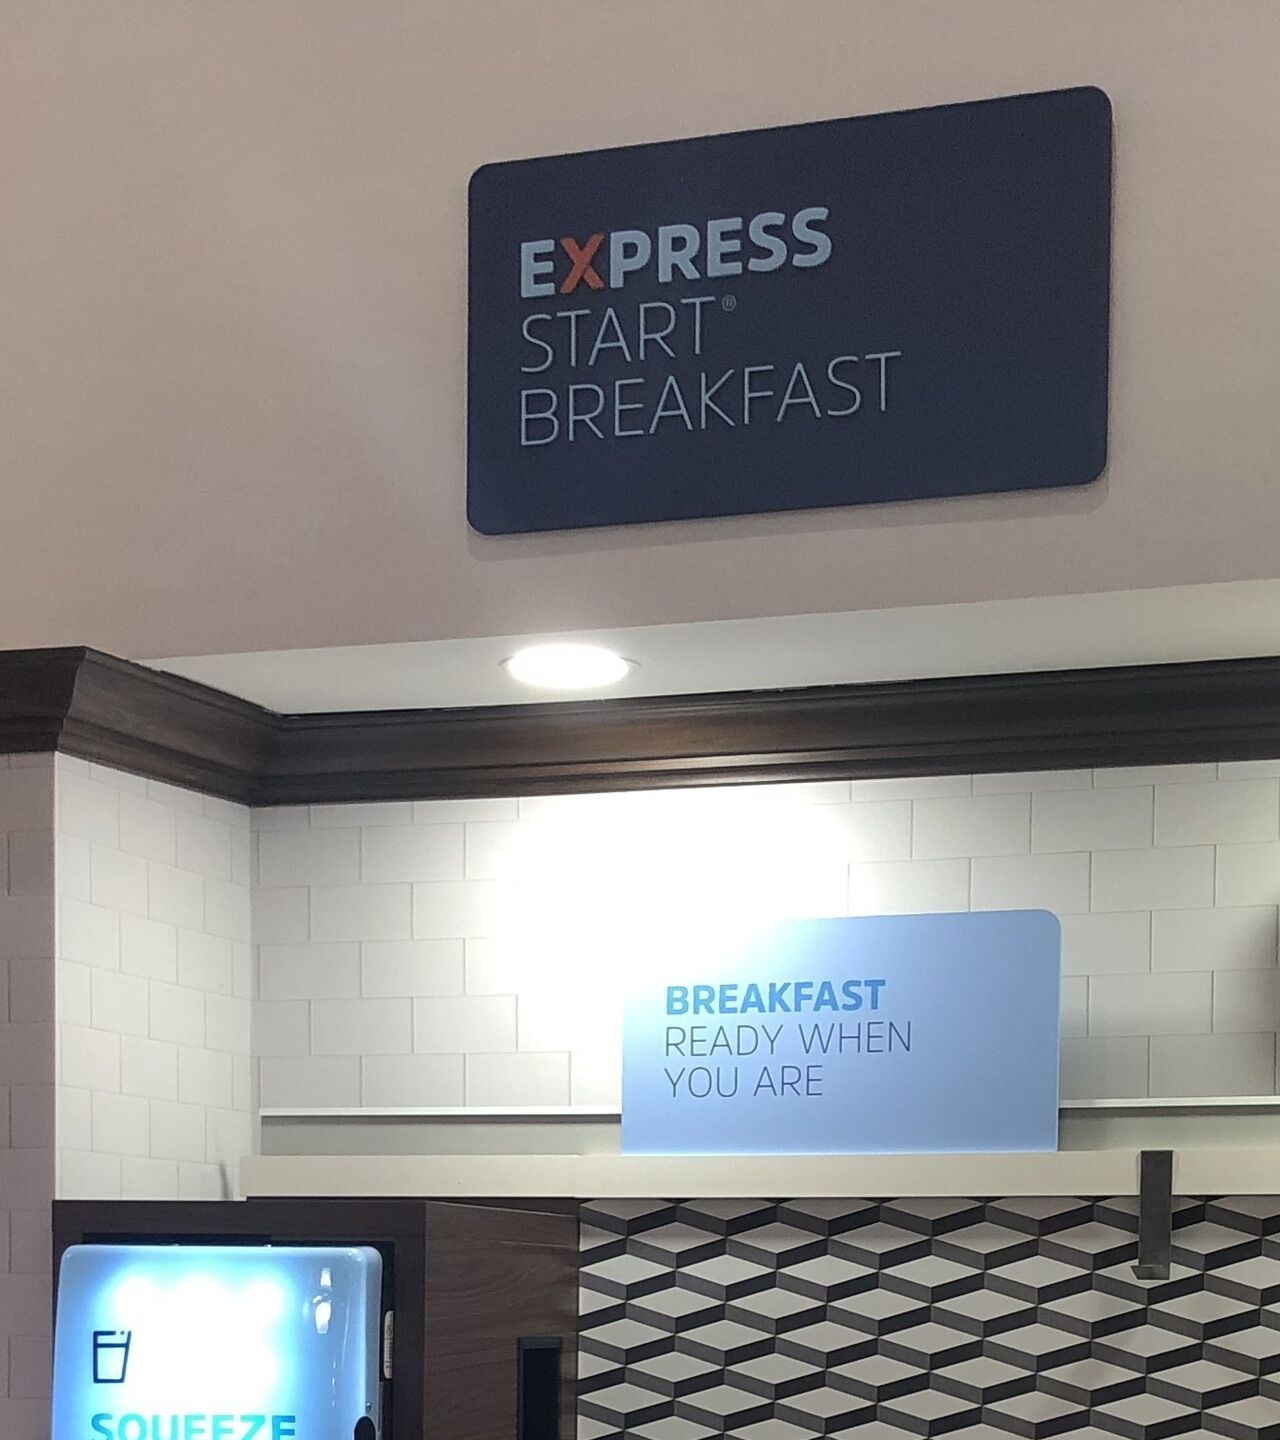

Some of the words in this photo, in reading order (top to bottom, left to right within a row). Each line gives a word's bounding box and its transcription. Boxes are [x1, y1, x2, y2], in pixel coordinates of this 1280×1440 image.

[520, 206, 832, 298] EXPRESS
[520, 350, 902, 446] BREAKFAST
[666, 979, 886, 1016] BREAKFAST
[664, 1024, 783, 1057] READY
[798, 1020, 913, 1054] WHEN
[664, 1066, 739, 1098] YOU
[753, 1064, 824, 1097] ARE
